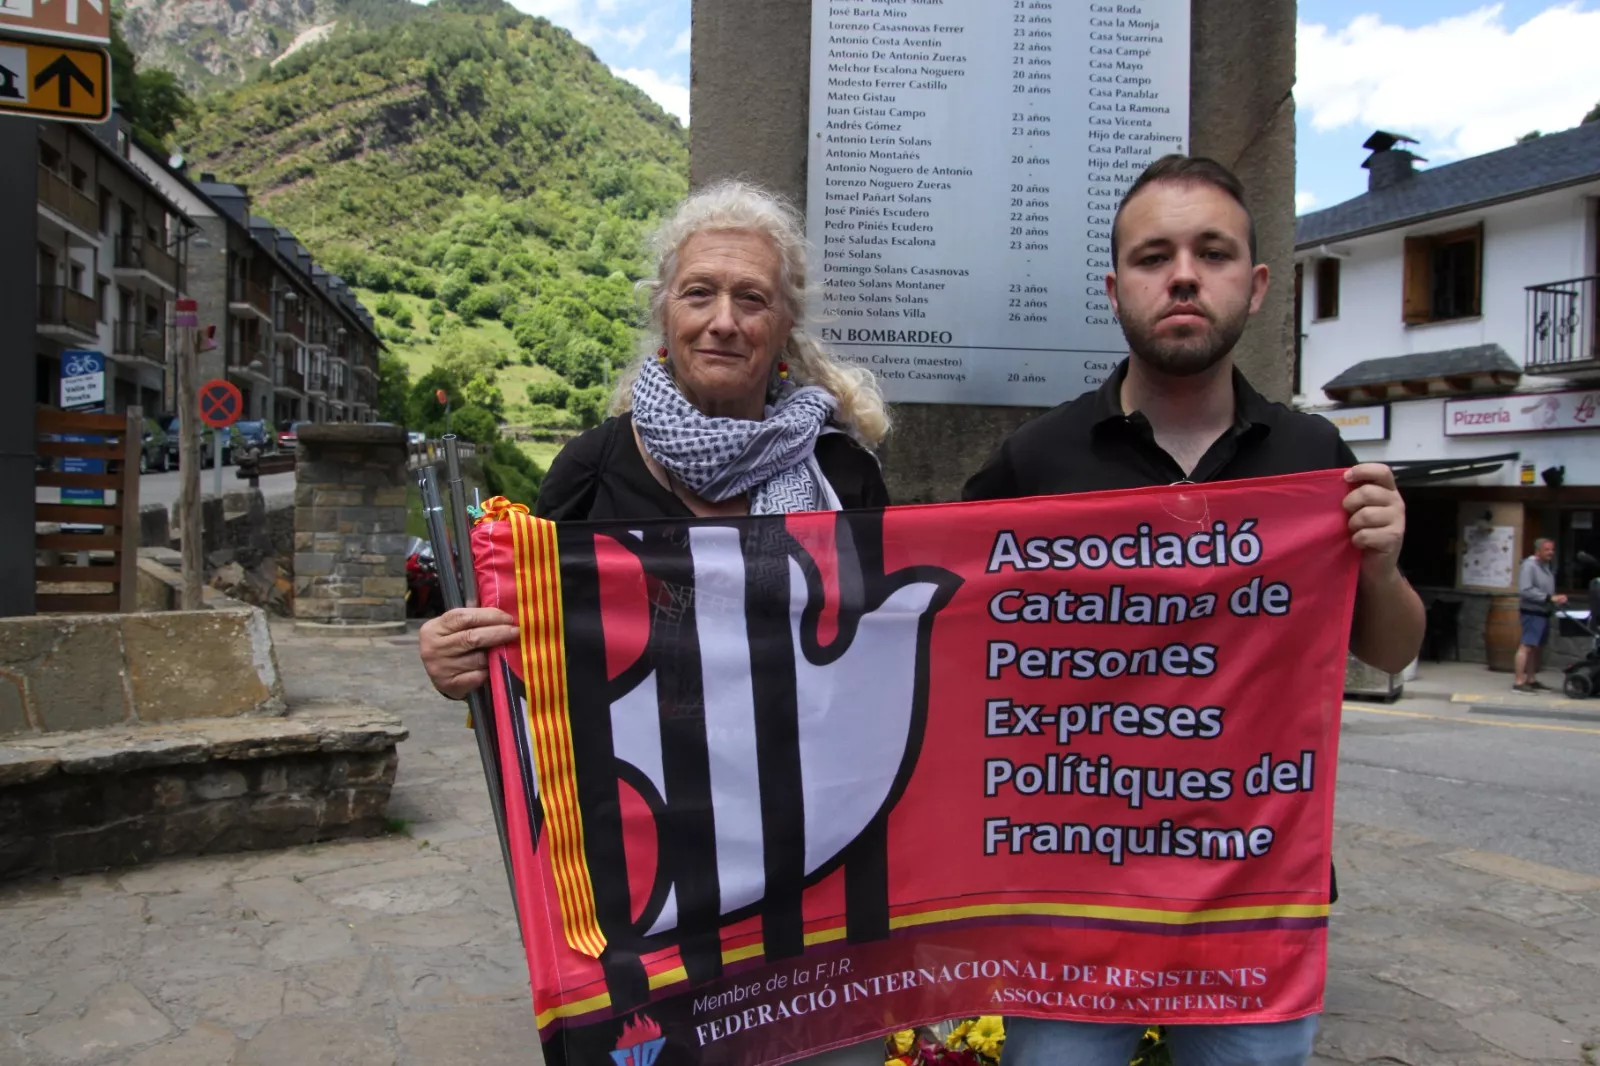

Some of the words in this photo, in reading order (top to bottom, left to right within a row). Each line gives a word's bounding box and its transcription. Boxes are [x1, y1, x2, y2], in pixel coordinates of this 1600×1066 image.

[829, 6, 850, 17] José
[1090, 3, 1113, 14] Casa
[1116, 4, 1142, 15] Roda
[1014, 13, 1026, 23] 22
[1028, 14, 1052, 24] años
[1089, 17, 1113, 28] Casa
[1116, 17, 1125, 28] la
[1128, 19, 1160, 32] Monja
[829, 20, 870, 32] Lorenzo
[872, 22, 930, 33] Casasnovas
[933, 23, 964, 34] Ferrer
[1014, 27, 1026, 37] 23
[1028, 28, 1052, 39] años
[828, 35, 869, 45] Antonio
[872, 35, 900, 47] Costa
[1090, 31, 1113, 42] Casa
[1013, 41, 1025, 52] 22
[1028, 42, 1052, 53] años
[1089, 45, 1113, 56] Casa
[828, 48, 869, 60] Antonio
[872, 50, 886, 60] De
[889, 50, 930, 61] Antonio
[932, 52, 966, 63] Zueras
[1013, 55, 1024, 65] 21
[1028, 56, 1052, 67] años
[828, 63, 871, 73] Melchor
[873, 64, 918, 75] Escalona
[920, 65, 965, 79] Noguero
[1089, 59, 1113, 70] Casa
[1116, 59, 1143, 73] Mayo
[1012, 69, 1025, 79] 20
[1028, 70, 1051, 80] años
[1088, 73, 1113, 84] Casa
[1115, 74, 1152, 89] Campo
[828, 77, 872, 88] Modesto
[875, 78, 906, 89] Ferrer
[909, 79, 947, 91] Castillo
[1012, 84, 1025, 94] 20
[1028, 85, 1051, 95] años
[828, 91, 860, 102] Mateo
[862, 92, 896, 103] Gistau
[1088, 87, 1112, 98] Casa
[827, 105, 850, 117] Juan
[853, 105, 886, 117] Gistau
[888, 107, 926, 121] Campo
[1088, 101, 1112, 112] Casa
[1115, 102, 1126, 114] La
[1129, 103, 1170, 115] Ramona
[1012, 112, 1024, 122] 23
[1027, 113, 1051, 123] años
[1088, 115, 1112, 126] Casa
[1114, 116, 1152, 129] Vicenta
[826, 119, 862, 131] Andrés
[864, 120, 902, 132] Gómez
[1012, 126, 1024, 136] 23
[1026, 127, 1050, 137] años
[826, 134, 867, 145] Antonio
[898, 136, 932, 147] Solans
[1088, 129, 1110, 142] Hijo
[1112, 129, 1126, 141] de
[1128, 131, 1182, 143] carabinero
[826, 148, 867, 159] Antonio
[1088, 143, 1112, 155] Casa
[1012, 155, 1024, 165] 20
[1026, 155, 1050, 166] años
[826, 162, 866, 173] Antonio
[869, 163, 914, 177] Noguero
[916, 165, 930, 175] de
[932, 165, 972, 176] Antonio
[826, 177, 867, 188] Lorenzo
[869, 178, 914, 191] Noguero
[916, 179, 951, 190] Zueras
[1011, 183, 1023, 193] 20
[1026, 183, 1050, 194] años
[826, 191, 859, 202] Ismael
[898, 193, 932, 204] Solans
[1010, 197, 1023, 208] 20
[1025, 198, 1049, 208] años
[825, 205, 846, 217] José
[849, 206, 880, 217] Piniés
[883, 207, 930, 218] Escudero
[1010, 211, 1023, 222] 22
[1025, 212, 1049, 223] años
[824, 219, 855, 231] Pedro
[858, 220, 889, 232] Piniés
[1010, 225, 1023, 236] 20
[1025, 226, 1048, 237] años
[824, 234, 846, 245] José
[848, 234, 888, 246] Saludas
[891, 236, 936, 247] Escalona
[1010, 240, 1022, 251] 23
[1025, 240, 1048, 251] años
[824, 248, 845, 260] José
[848, 249, 882, 260] Solans
[824, 263, 872, 277] Domingo
[874, 264, 908, 275] Solans
[910, 265, 969, 277] Casasnovas
[858, 278, 892, 289] Solans
[895, 279, 945, 291] Montaner
[1009, 283, 1022, 294] 23
[1024, 283, 1048, 294] años
[858, 292, 892, 304] Solans
[895, 293, 928, 305] Solans
[1009, 298, 1021, 308] 22
[1024, 298, 1047, 309] años
[866, 307, 900, 318] Solans
[902, 308, 926, 319] Villa
[1008, 311, 1021, 322] 26
[1024, 312, 1047, 323] años
[821, 328, 842, 341] EN
[848, 329, 953, 345] BOMBARDEO
[872, 353, 910, 365] Calvera
[913, 356, 963, 367] (maestro)
[908, 370, 966, 382] Casasnovas
[986, 519, 1263, 572] Associació
[988, 585, 1217, 624] Catalana
[1229, 576, 1292, 617] de
[986, 640, 1219, 679] Persones
[985, 698, 1224, 745] Ex-preses
[984, 753, 1235, 809] Polítiques
[1244, 751, 1316, 797] del
[984, 817, 1275, 865] Franquisme
[692, 982, 761, 1015] Membre
[766, 972, 788, 992] de
[793, 969, 809, 985] la
[815, 958, 855, 981] F.I.R.
[695, 983, 837, 1048] FEDERACIÓ
[843, 959, 1054, 1004] INTERNACIONAL
[1063, 964, 1098, 983] DE
[1105, 965, 1268, 988] RESISTENTS
[990, 987, 1116, 1011] ASSOCIACIÓ
[1123, 994, 1264, 1012] ANTIFEIXISTA
